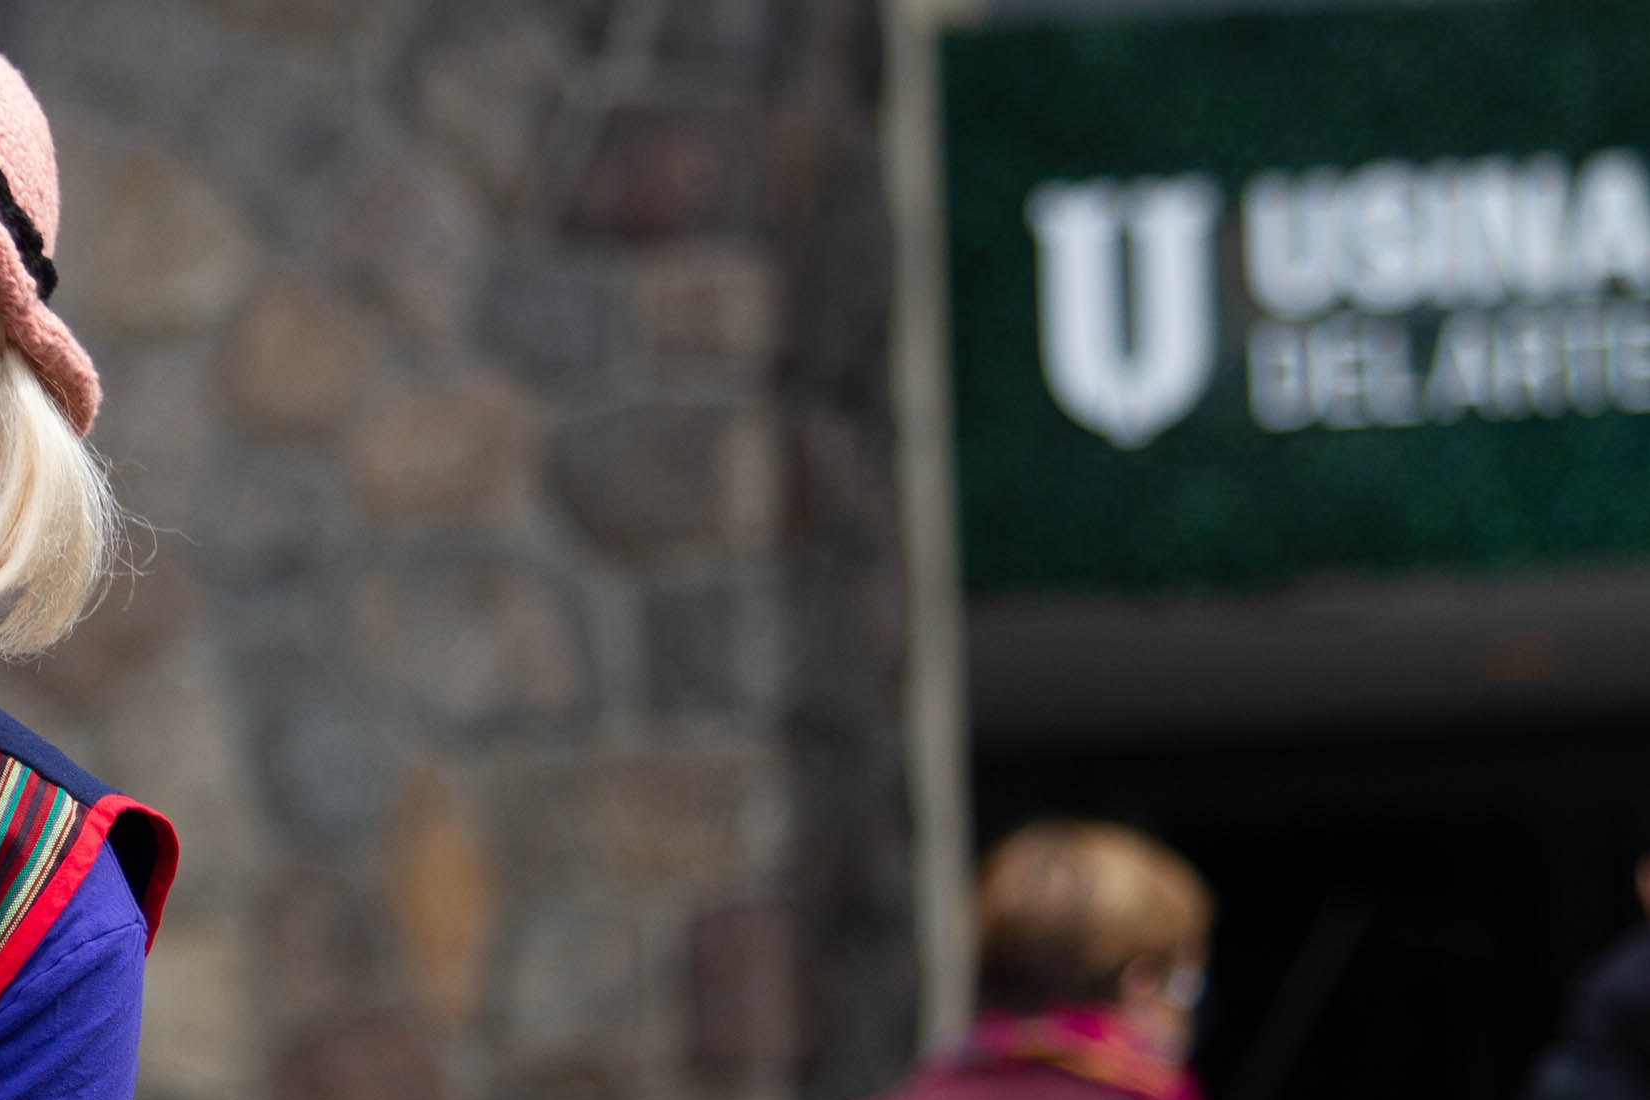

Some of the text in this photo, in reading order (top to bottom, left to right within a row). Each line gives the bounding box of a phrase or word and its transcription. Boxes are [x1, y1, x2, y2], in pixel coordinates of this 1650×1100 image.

[1028, 178, 1220, 448] U
[1242, 152, 1650, 320] USINA
[1246, 318, 1424, 433] DEL
